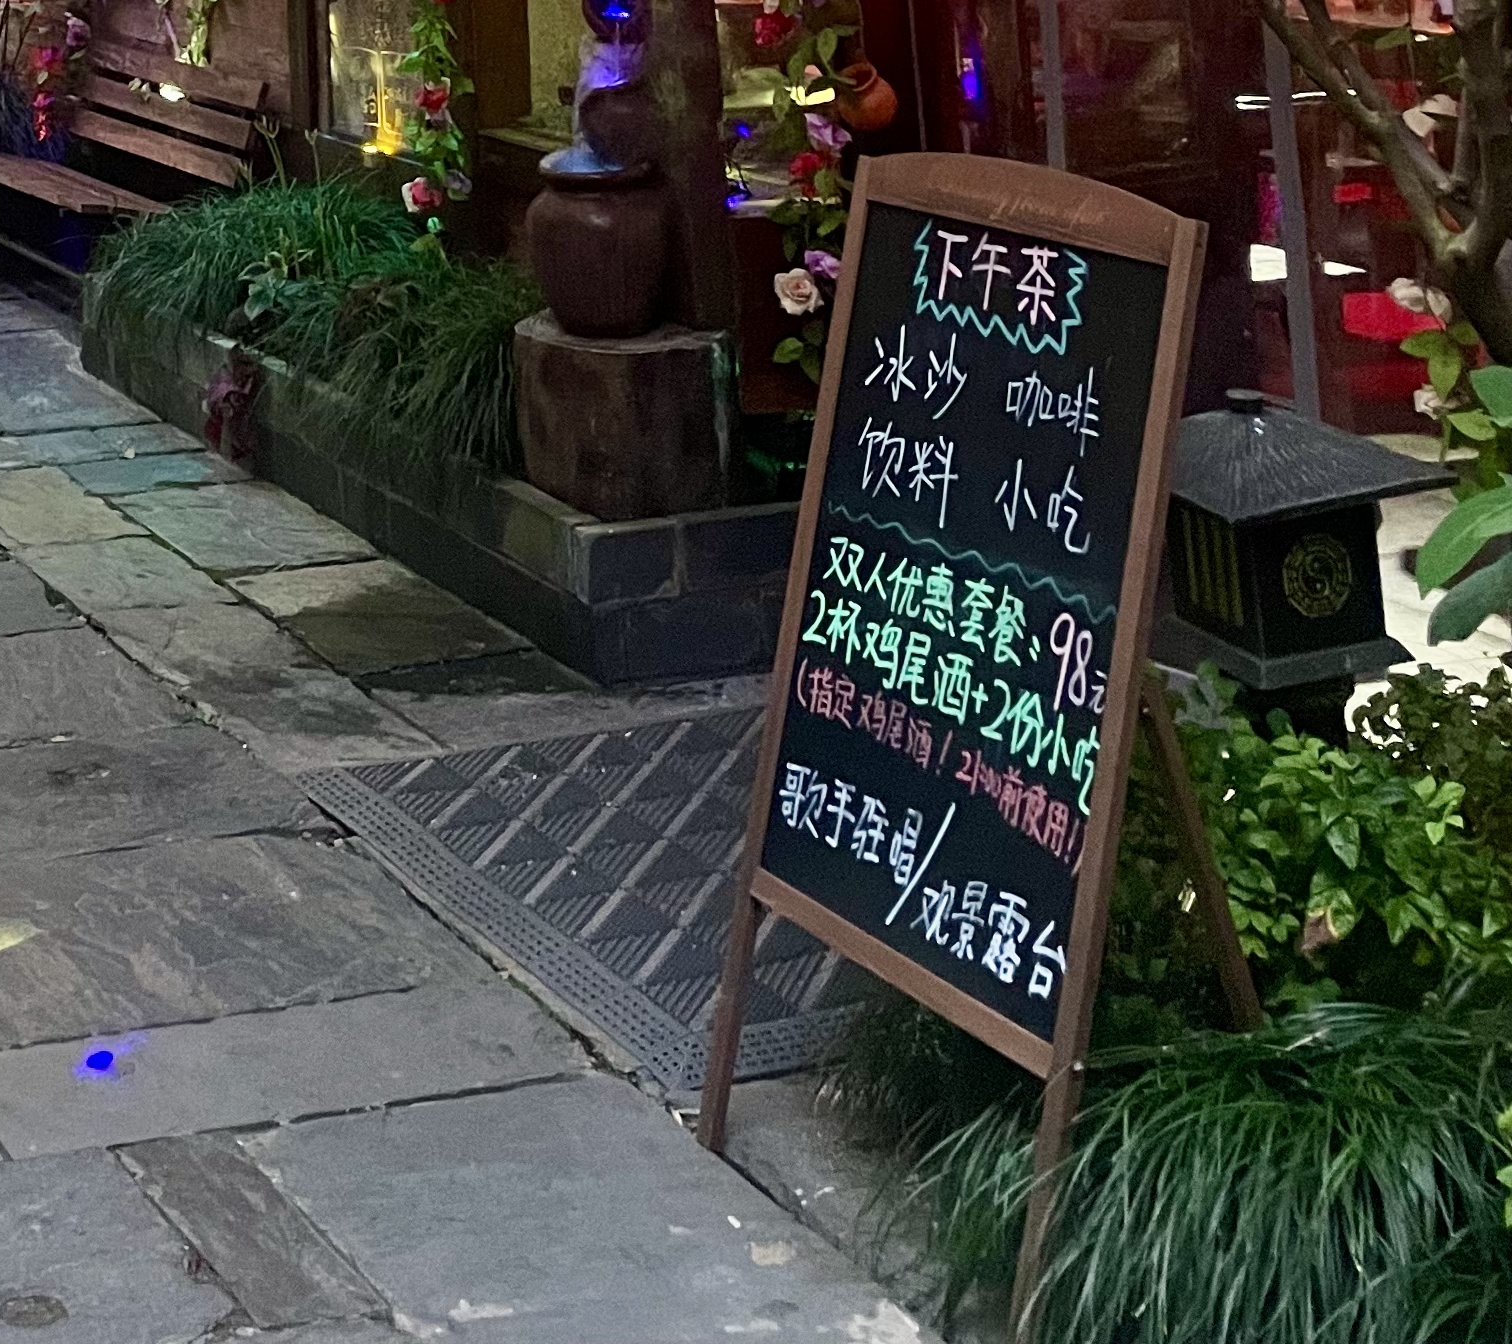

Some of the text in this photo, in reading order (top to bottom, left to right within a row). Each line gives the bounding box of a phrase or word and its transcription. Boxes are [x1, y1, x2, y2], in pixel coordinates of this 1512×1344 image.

[936, 228, 1060, 325] 下午茶
[863, 323, 1100, 457] 冰沙 咖啡
[857, 416, 1091, 554] 饮料 小吃
[802, 589, 1101, 816] 2杯鸡尾酒+2份小吃
